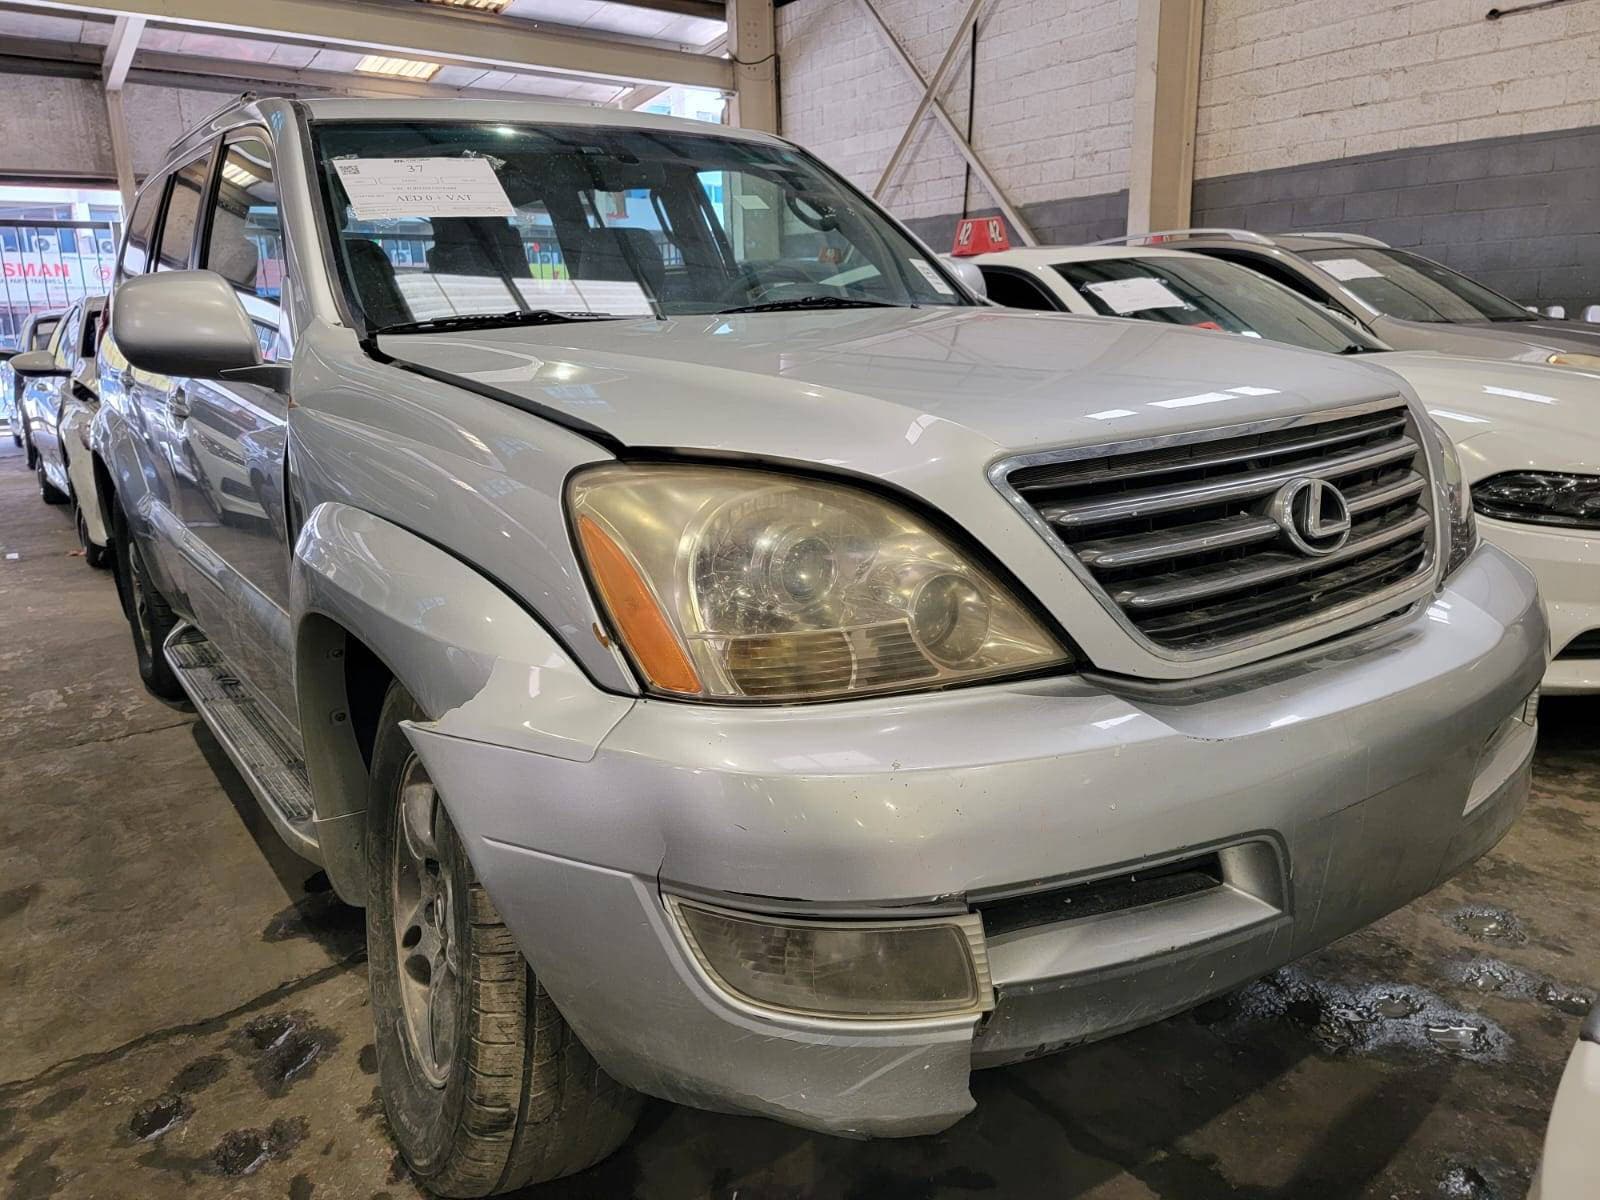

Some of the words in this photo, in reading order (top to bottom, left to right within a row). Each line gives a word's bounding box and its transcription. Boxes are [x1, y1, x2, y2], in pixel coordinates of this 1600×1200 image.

[406, 164, 423, 173] 37
[396, 194, 423, 202] AED
[445, 193, 472, 201] VAT
[959, 222, 973, 246] 42
[988, 219, 1004, 243] 42
